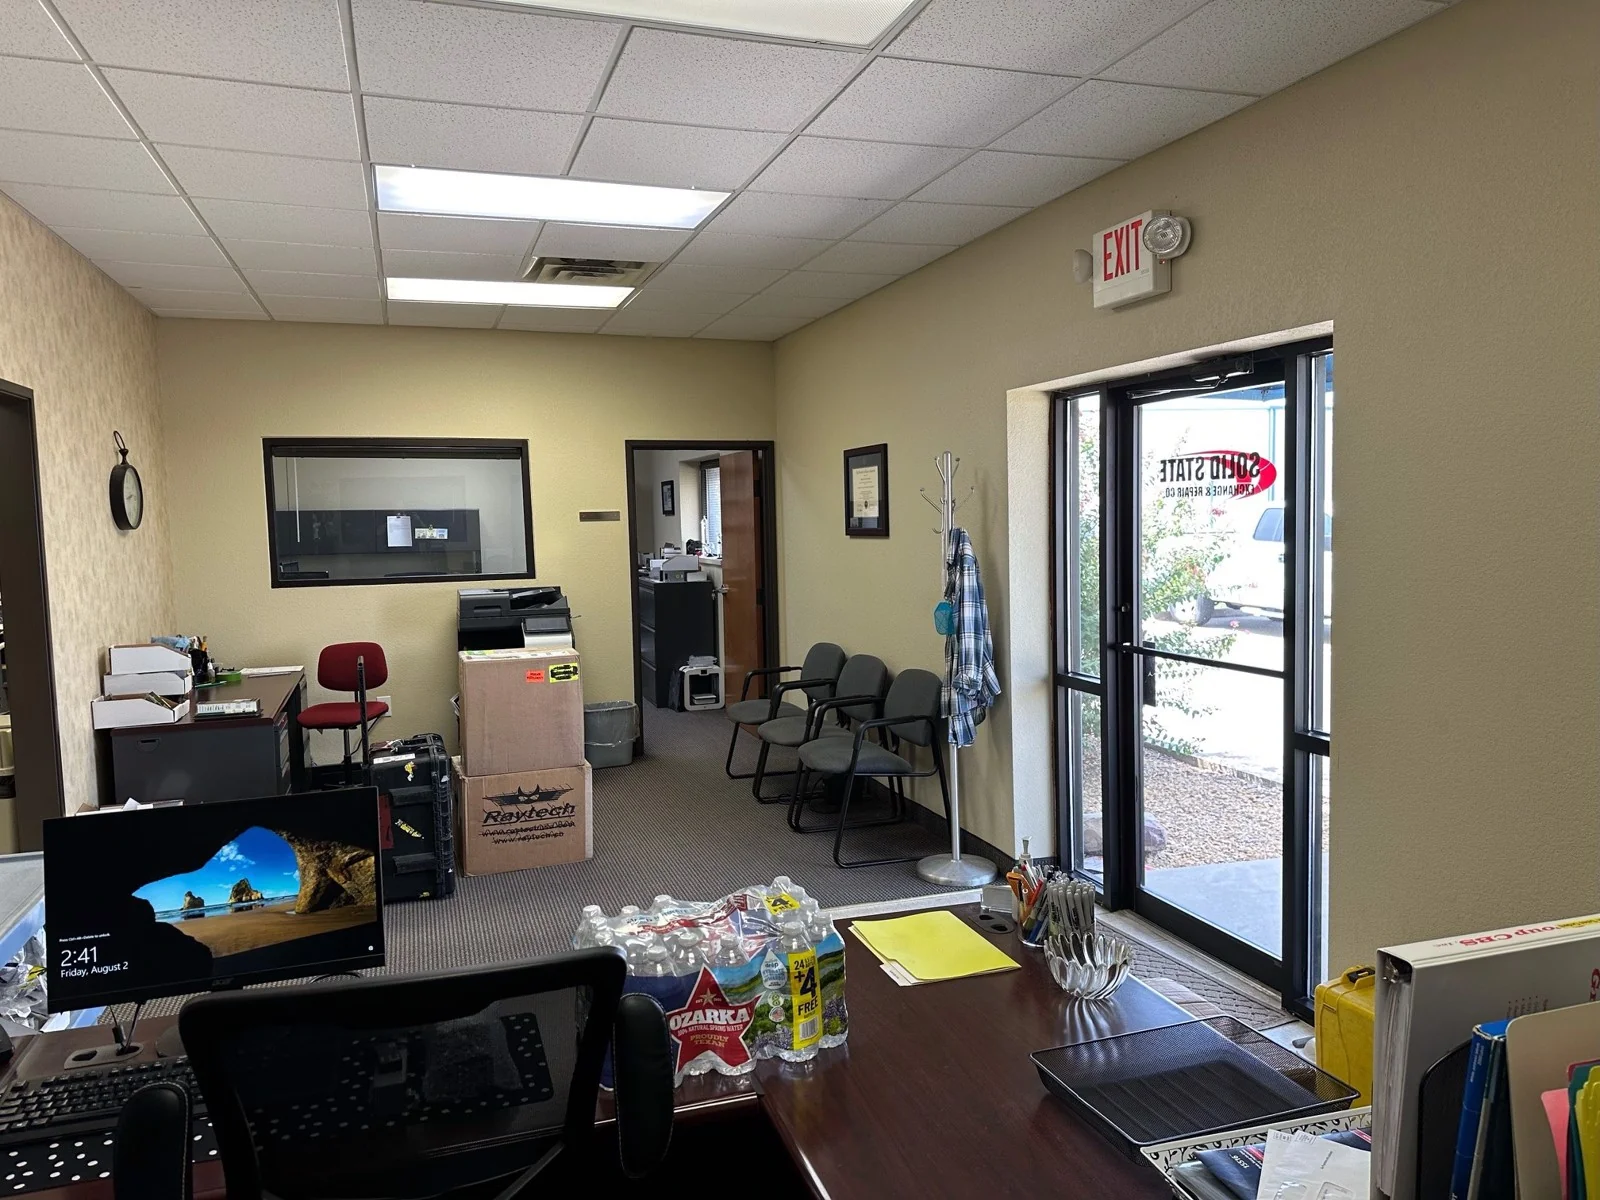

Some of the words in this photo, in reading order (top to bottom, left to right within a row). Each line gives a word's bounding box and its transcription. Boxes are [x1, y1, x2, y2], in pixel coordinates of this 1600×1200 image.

[1103, 219, 1142, 281] EXIT
[483, 802, 575, 824] Raytech
[61, 946, 97, 967] 2:41
[794, 959, 805, 971] 24
[61, 967, 89, 978] Friday,
[91, 963, 121, 975] August
[122, 961, 129, 970] 2
[798, 996, 818, 1015] FREE
[669, 1007, 750, 1031] OZARKA
[688, 1024, 710, 1033] NATURAL
[709, 1024, 726, 1032] SPRING
[726, 1023, 744, 1032] WATER
[690, 1033, 729, 1043] PROUDLY
[694, 1039, 725, 1048] TEXAN
